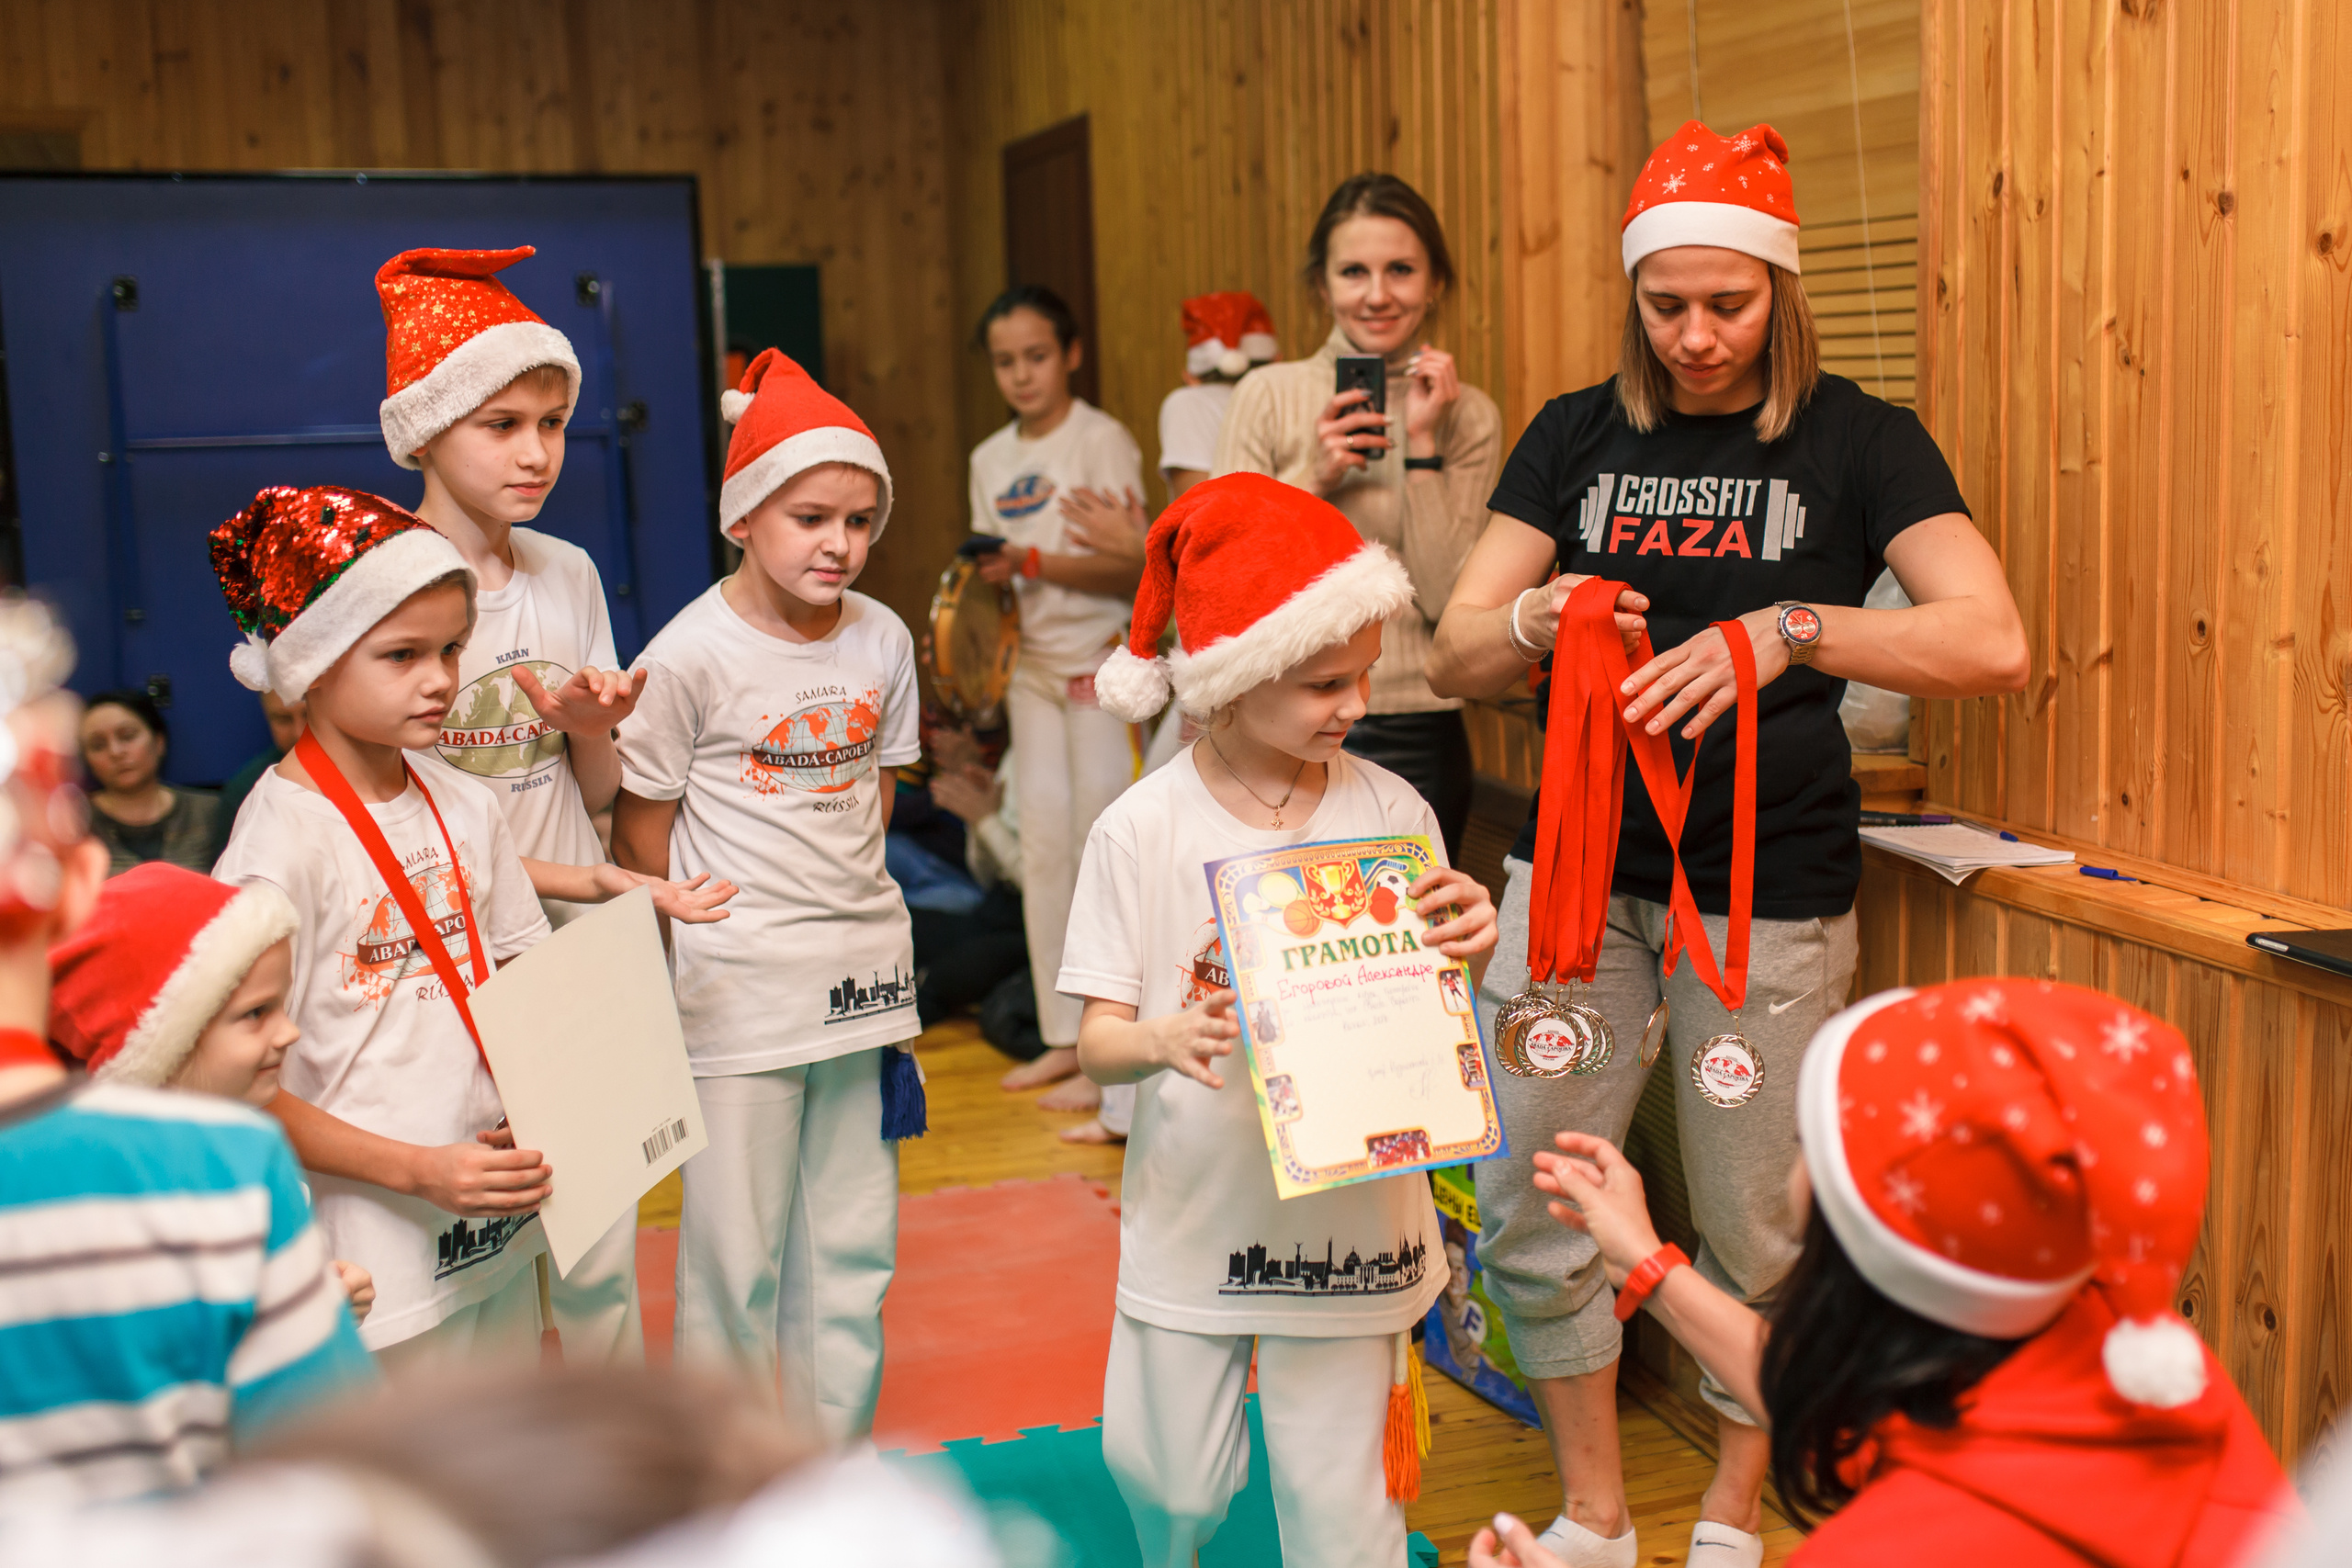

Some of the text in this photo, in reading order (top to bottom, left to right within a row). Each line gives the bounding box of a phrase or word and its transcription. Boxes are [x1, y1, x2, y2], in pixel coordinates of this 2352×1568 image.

[1615, 474, 1762, 516] CROSSFIT
[1608, 515, 1753, 558] FAZA
[795, 685, 847, 705] SAMARA
[1281, 930, 1421, 971] ГРАМОТА
[1277, 974, 1352, 1005] Егоровой
[1357, 964, 1434, 986] Александре
